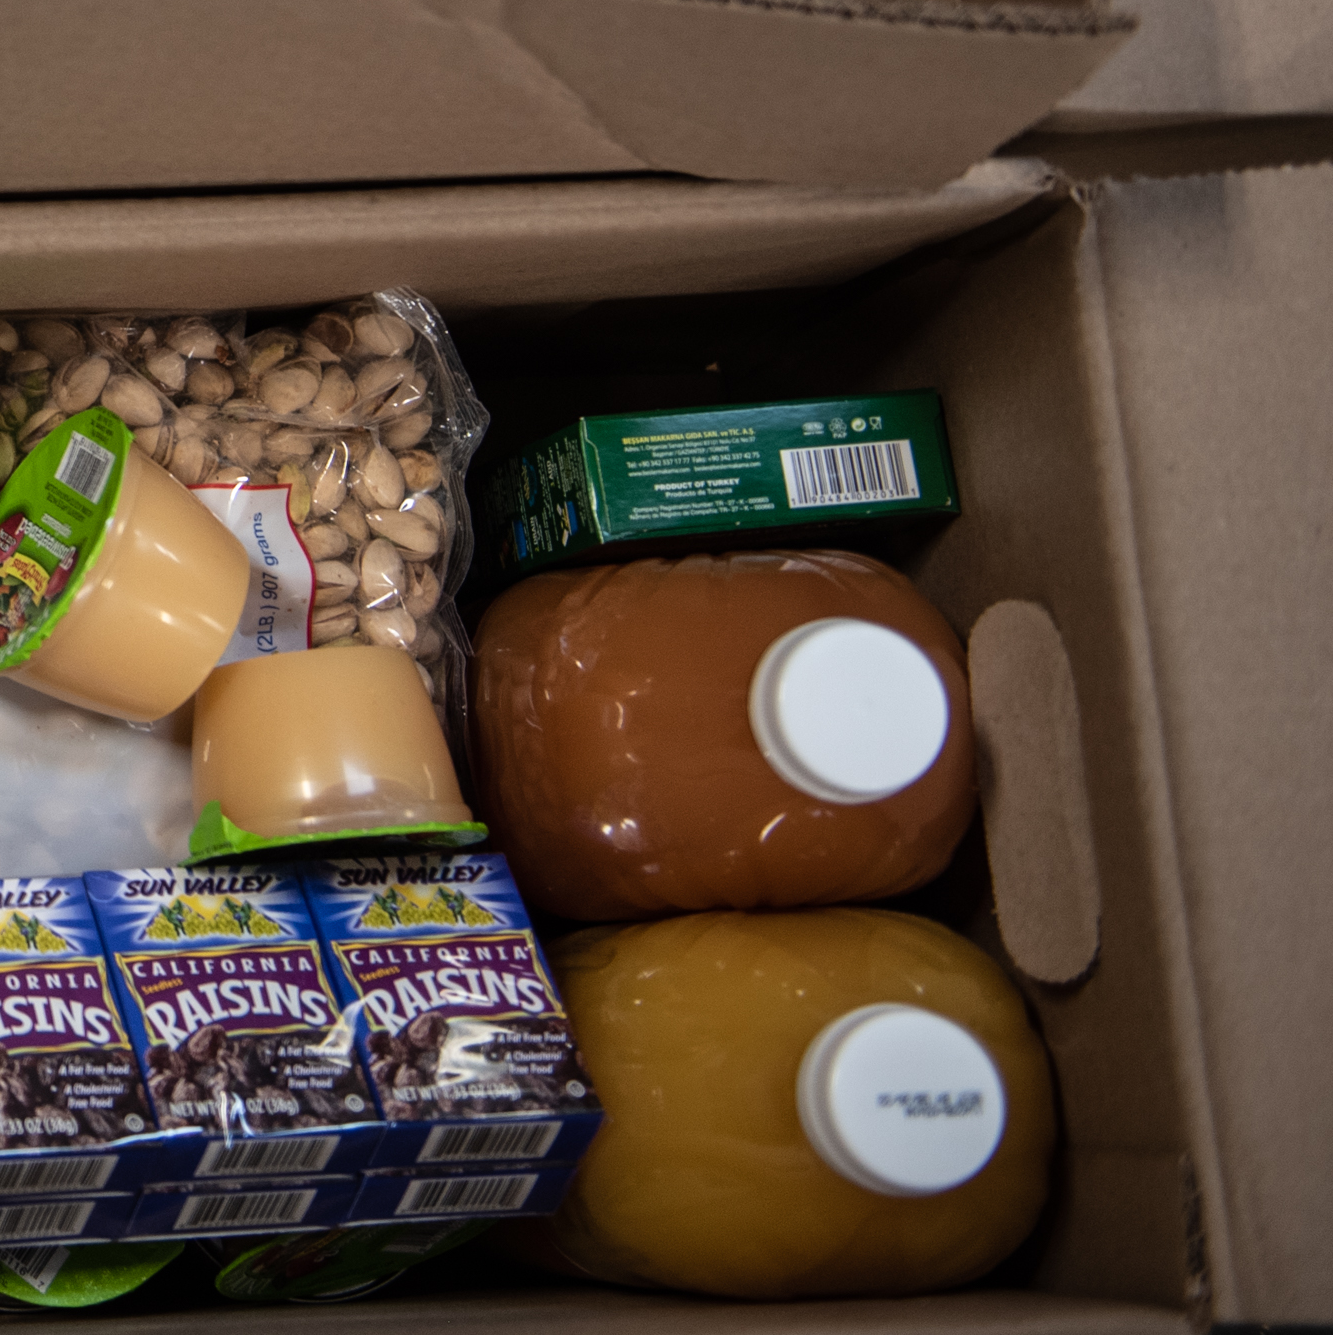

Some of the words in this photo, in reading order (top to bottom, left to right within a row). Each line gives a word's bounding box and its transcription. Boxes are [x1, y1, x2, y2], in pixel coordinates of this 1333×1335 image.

[653, 480, 687, 493] PRODUCT
[688, 480, 704, 491] OF
[705, 477, 741, 491] TURKEY
[255, 511, 281, 566] grams
[260, 568, 278, 599] 907
[255, 598, 277, 656] (2LB.)
[123, 877, 177, 898] SUN
[183, 874, 273, 896] VALLEY
[337, 867, 390, 887] SUN
[395, 864, 486, 884] VALLEY
[131, 955, 314, 979] CALIFORNIA
[349, 944, 528, 966] CALIFORNIA
[144, 978, 329, 1051] RAISINS
[363, 966, 545, 1038] RAISINS
